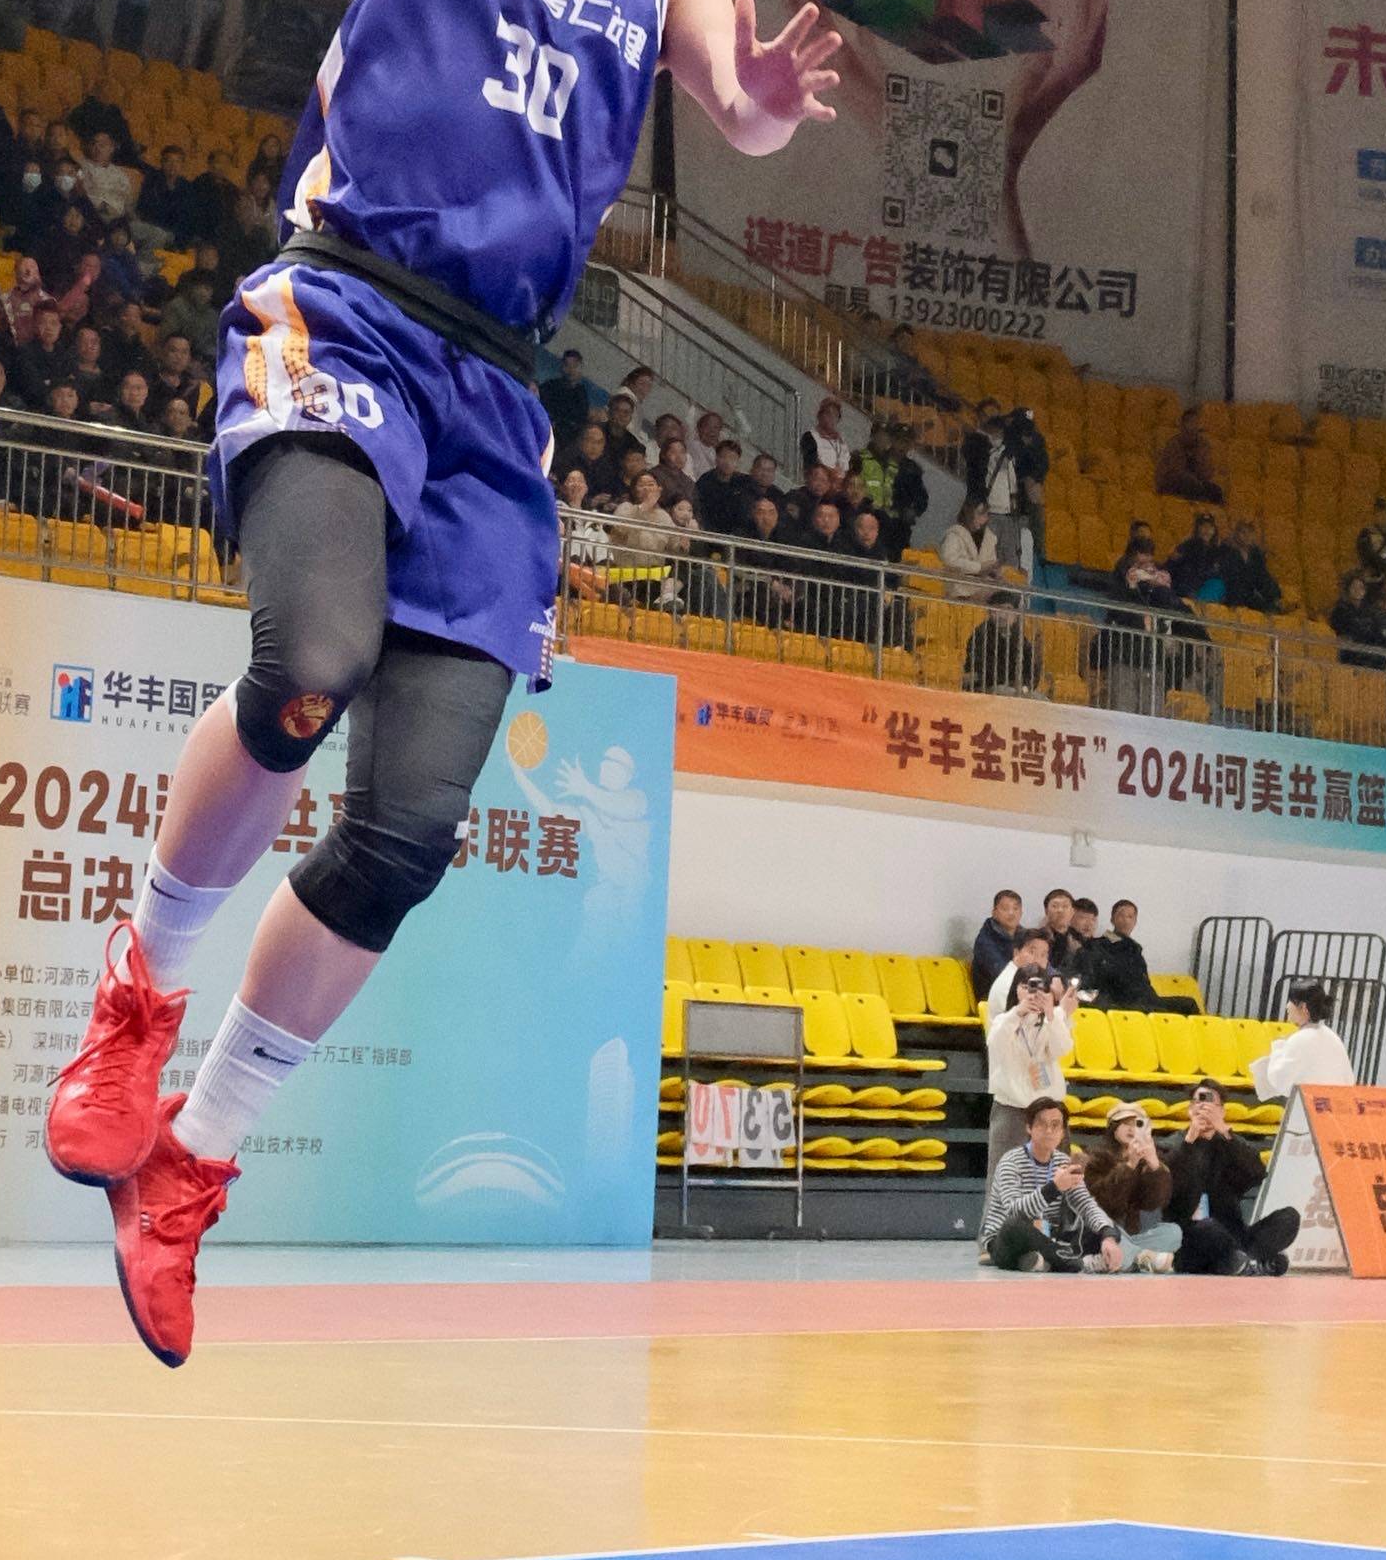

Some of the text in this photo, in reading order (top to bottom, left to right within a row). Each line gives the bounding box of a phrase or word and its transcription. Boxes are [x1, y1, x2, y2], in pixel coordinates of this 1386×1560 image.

[481, 11, 580, 141] 30
[743, 214, 1139, 319] 谋道广告装饰有限公司
[298, 371, 385, 430] 30
